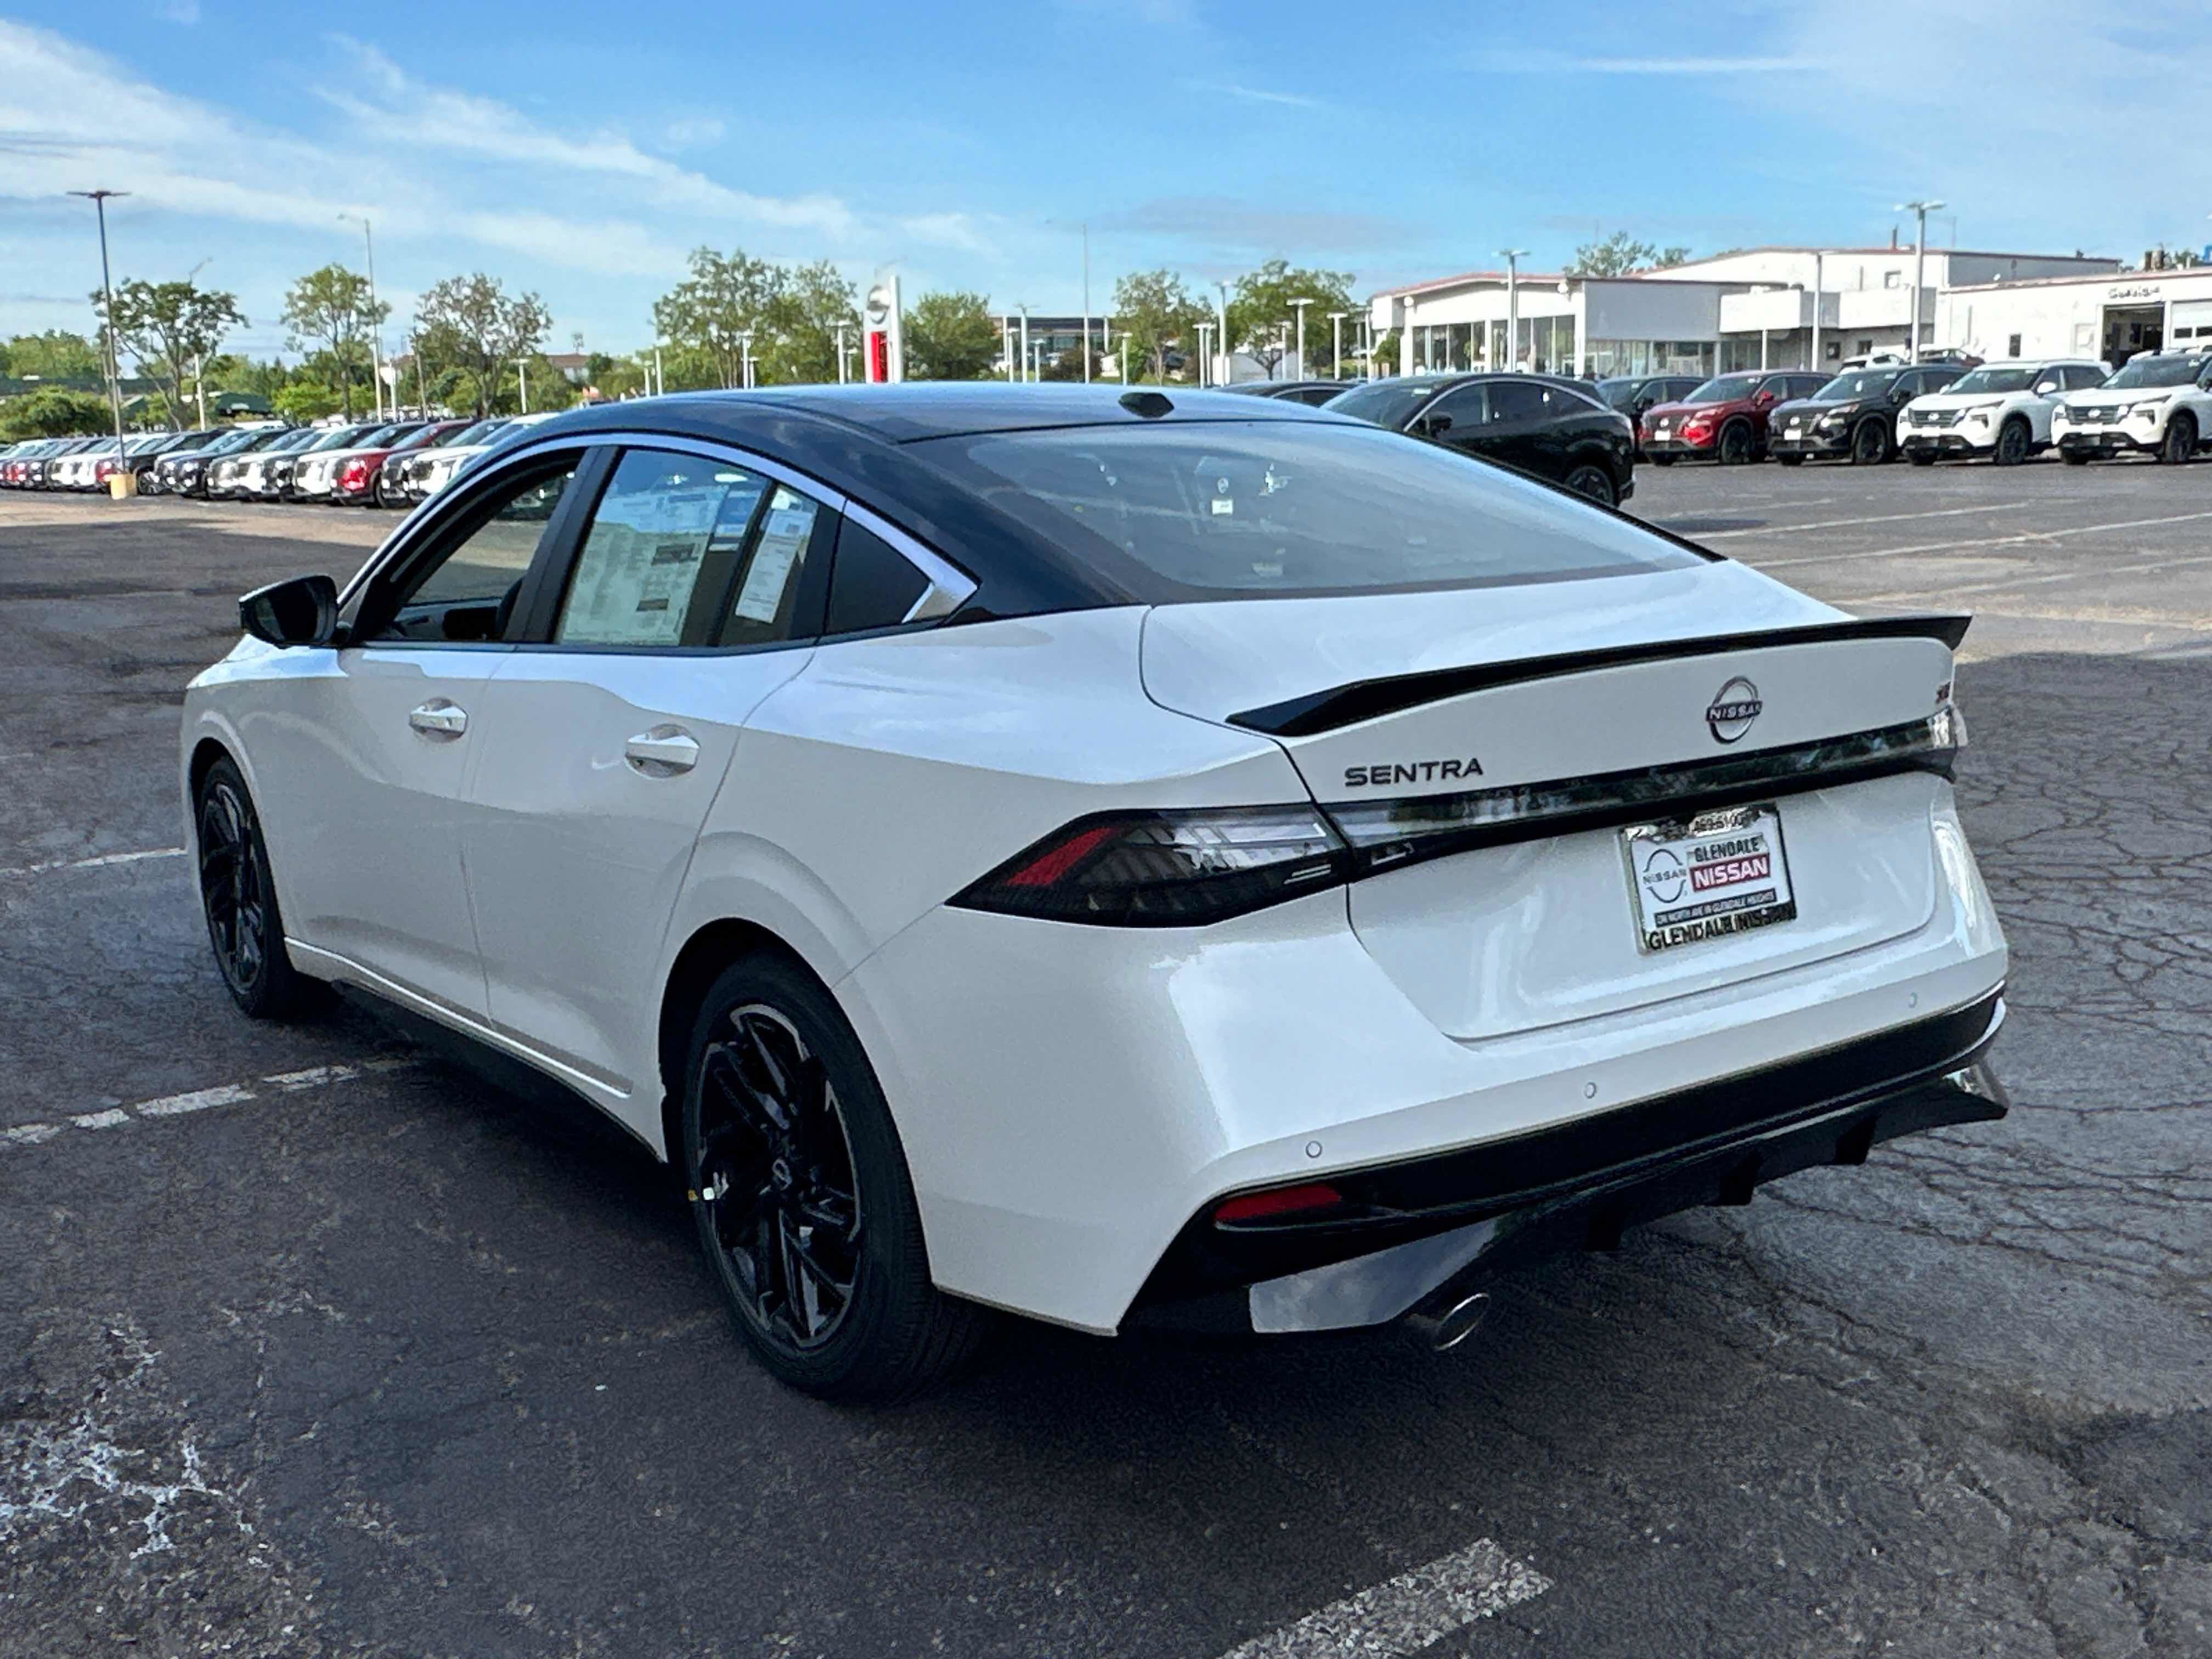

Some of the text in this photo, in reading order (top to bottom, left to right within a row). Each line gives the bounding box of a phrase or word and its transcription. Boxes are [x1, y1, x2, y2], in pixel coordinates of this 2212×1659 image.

[1708, 702, 1762, 721] NISSAN
[1345, 758, 1483, 787] SENTRA
[1694, 837, 1760, 861] GLENDALE
[1694, 857, 1768, 888] NISSAN
[1649, 916, 1734, 950] GLENDALE
